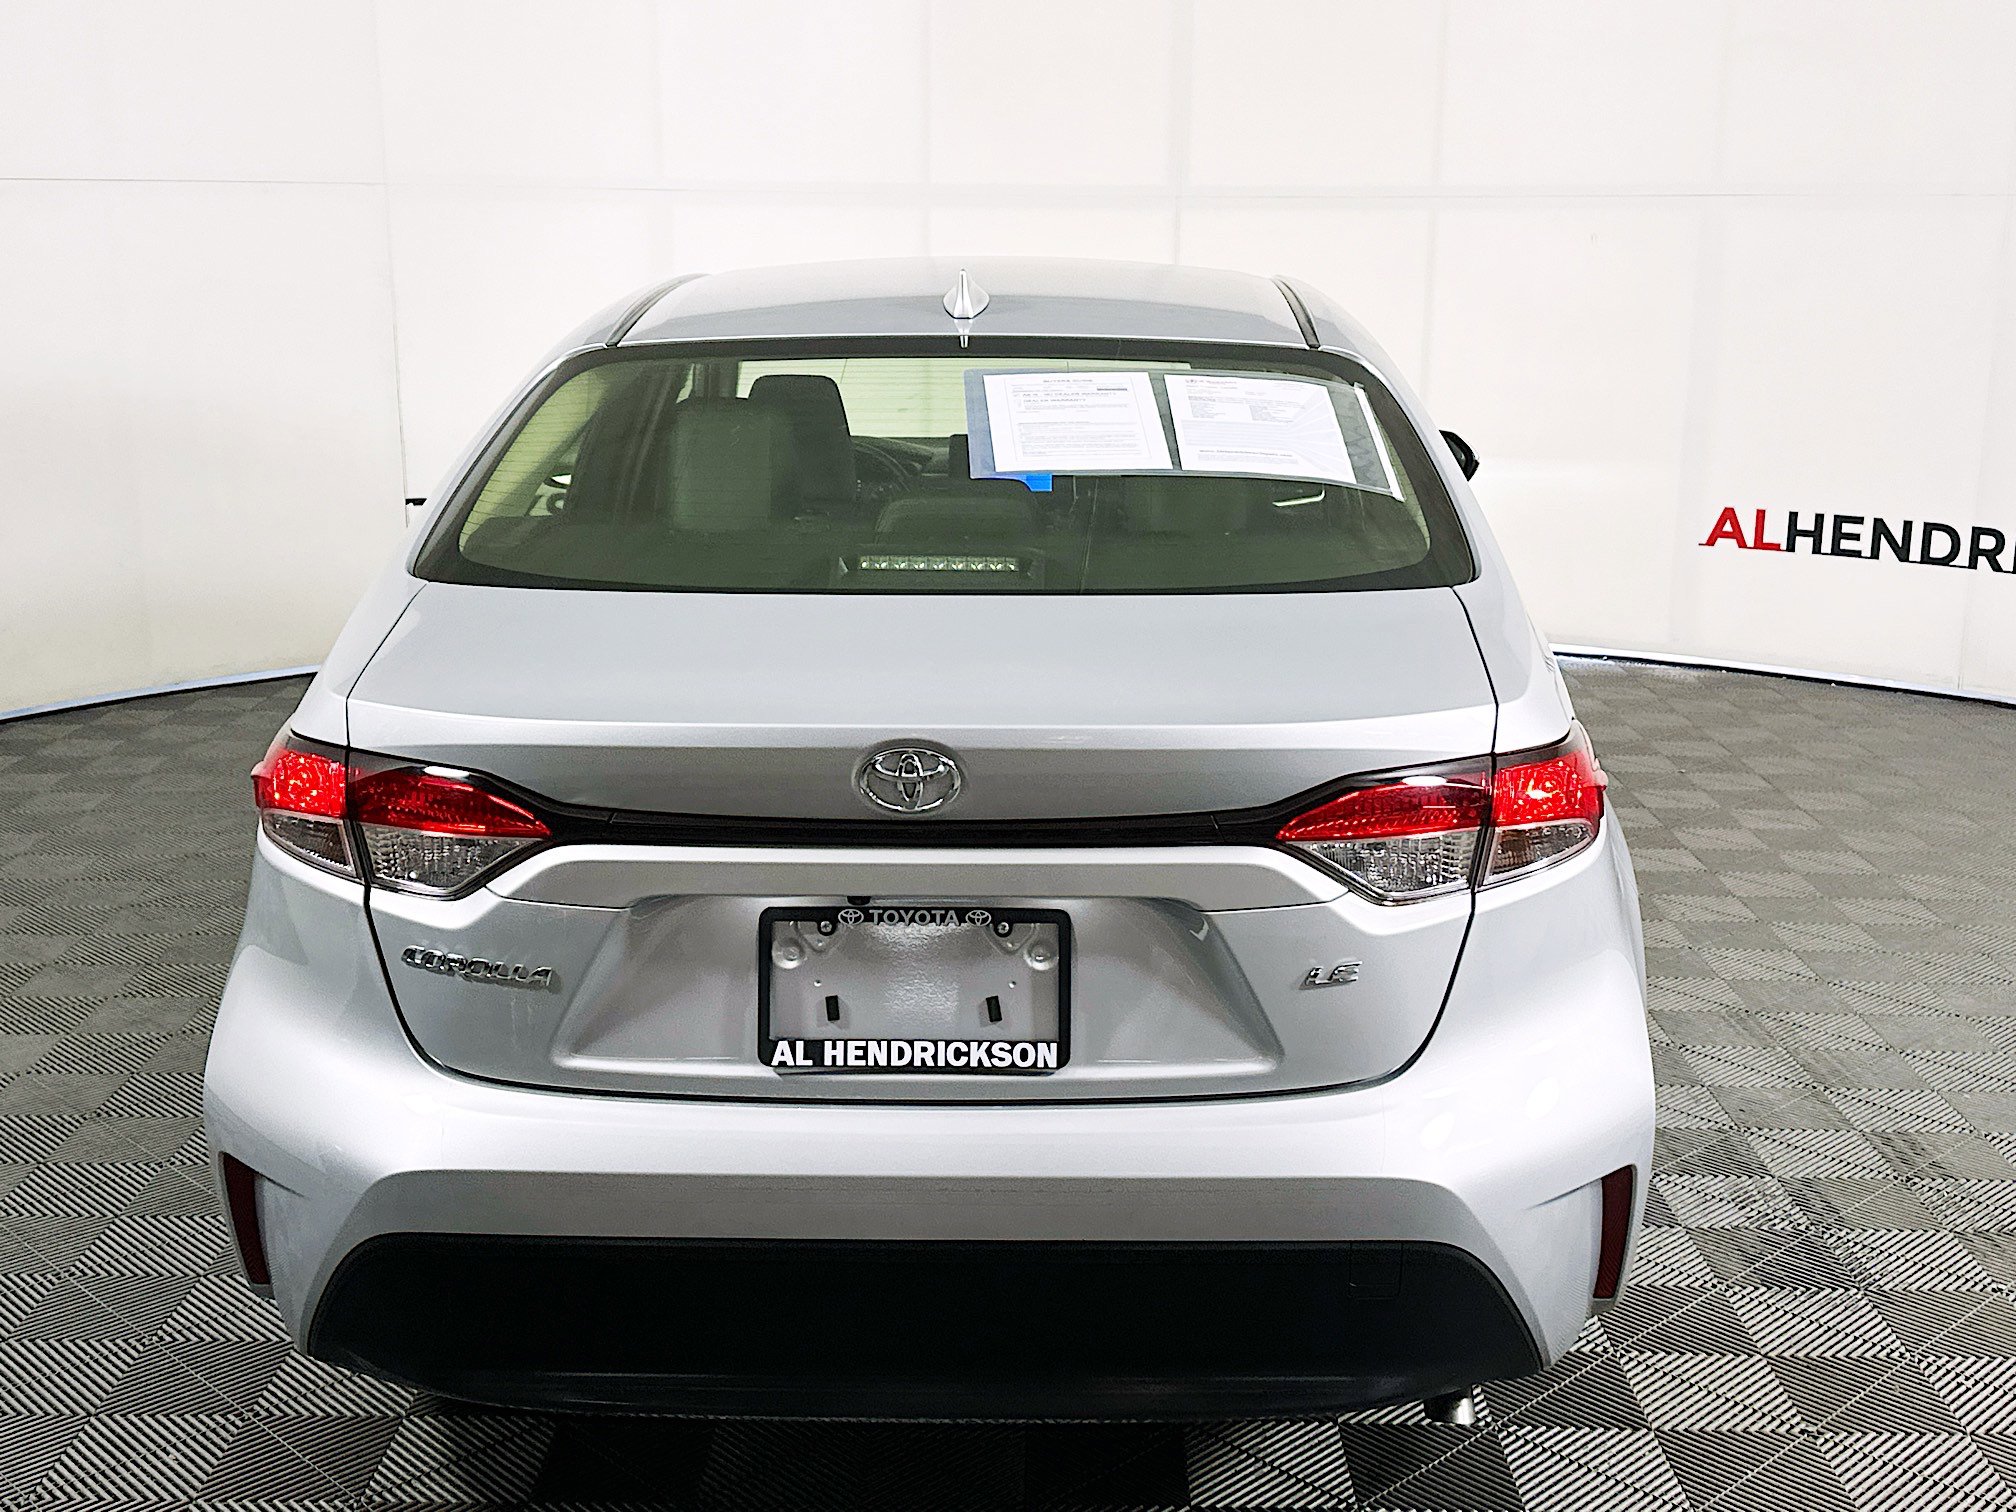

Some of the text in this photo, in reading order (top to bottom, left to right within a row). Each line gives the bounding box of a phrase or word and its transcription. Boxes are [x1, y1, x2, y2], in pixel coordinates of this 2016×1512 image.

[869, 909, 960, 926] TOYOTA
[401, 944, 554, 988] COROLLA
[1304, 960, 1363, 986] LE
[771, 1040, 1058, 1068] AL HENDRICKSON
